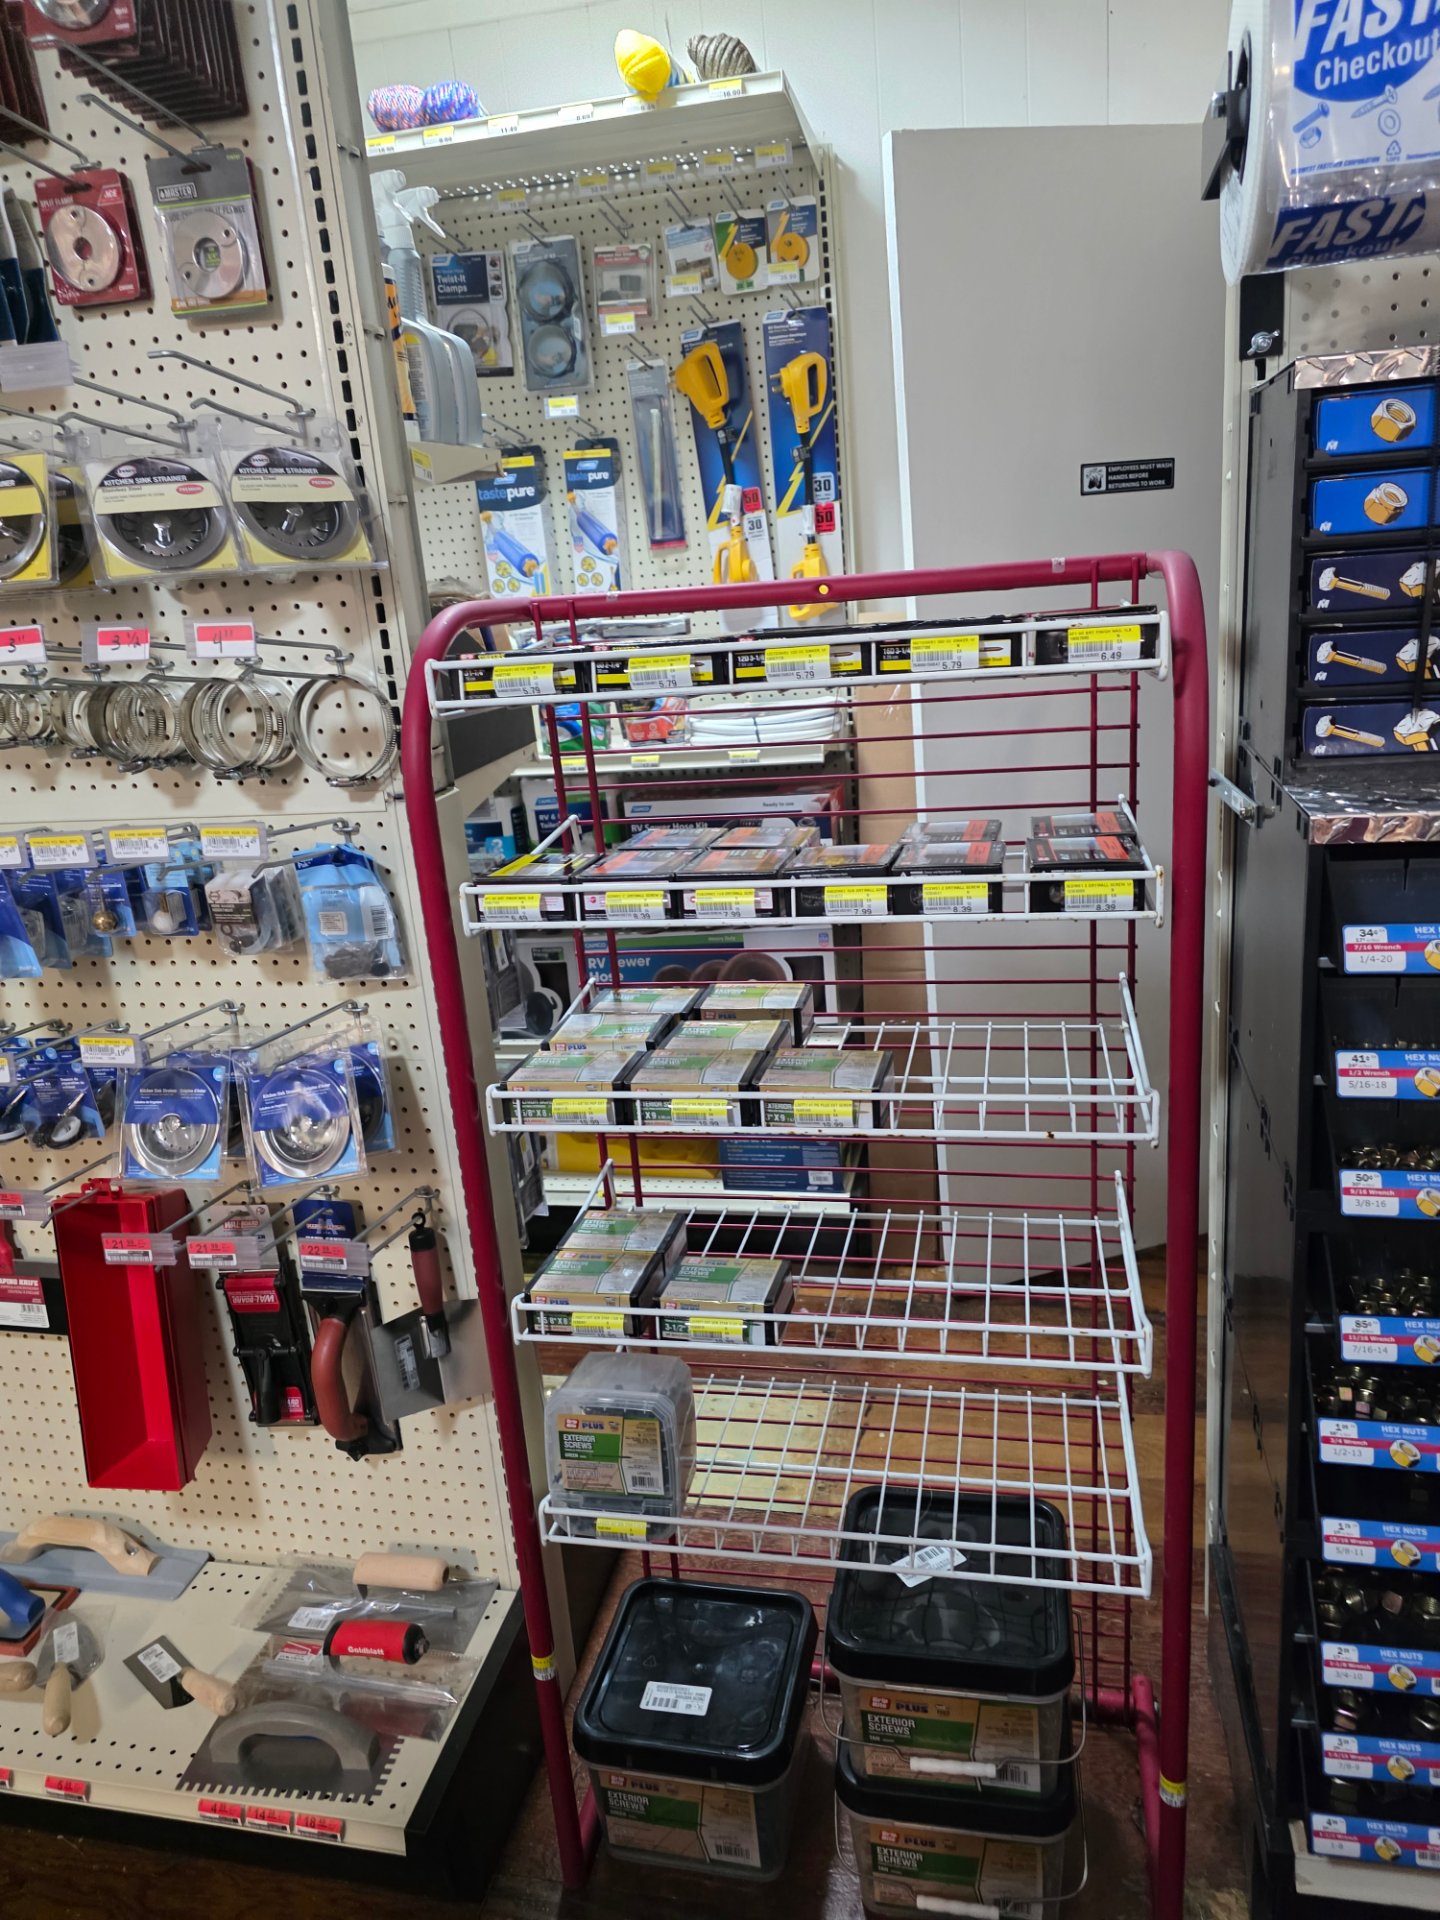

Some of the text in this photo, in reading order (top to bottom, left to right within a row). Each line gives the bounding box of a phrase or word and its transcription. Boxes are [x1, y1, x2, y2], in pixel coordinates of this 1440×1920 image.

[1269, 196, 1414, 258] FAST
[239, 466, 319, 475] KITCHEN SINK STRAINER
[1139, 462, 1155, 471] MUST
[1156, 461, 1173, 470] WASH
[104, 474, 187, 487] KITCHEN SINK STRAINER
[814, 478, 831, 492] 30
[1149, 479, 1166, 487] WORK
[815, 509, 833, 524] 50
[747, 519, 763, 531] 30
[1100, 651, 1122, 661] 6.49
[942, 660, 962, 670] 5.79
[795, 670, 815, 680] 5.79
[658, 679, 677, 688] 5.79
[522, 686, 541, 695] 5.79
[1414, 926, 1436, 934] HEX
[588, 956, 651, 968] RV ewer
[1360, 954, 1393, 965] 1/4-20
[1404, 1053, 1426, 1061] HEX
[1348, 1080, 1387, 1089] 5/16-18
[1406, 1173, 1427, 1182] HEX
[1355, 1199, 1387, 1208] 3/8-16
[1404, 1320, 1425, 1329] HEX
[1352, 1344, 1388, 1354] 7/16-14
[581, 1422, 605, 1430] PLUS
[1381, 1425, 1428, 1436] HEX NUTS
[562, 1433, 596, 1443] EXTERIOR
[563, 1442, 593, 1450] SCREWS
[1382, 1524, 1428, 1536] HEX NUTS
[347, 1645, 385, 1656] Goldblatt
[1380, 1649, 1424, 1661] HEX NUTS
[895, 1702, 929, 1714] PLUS
[867, 1714, 916, 1729] EXTERIOR
[868, 1723, 911, 1736] SCREWS
[1379, 1740, 1422, 1752] HEX NUTS
[607, 1790, 650, 1806] EXTERIOR
[608, 1798, 645, 1812] SCREWS
[1366, 1820, 1408, 1834] HEX NUTS
[876, 1846, 924, 1863] EXTERIOR
[876, 1854, 919, 1869] SCREWS
